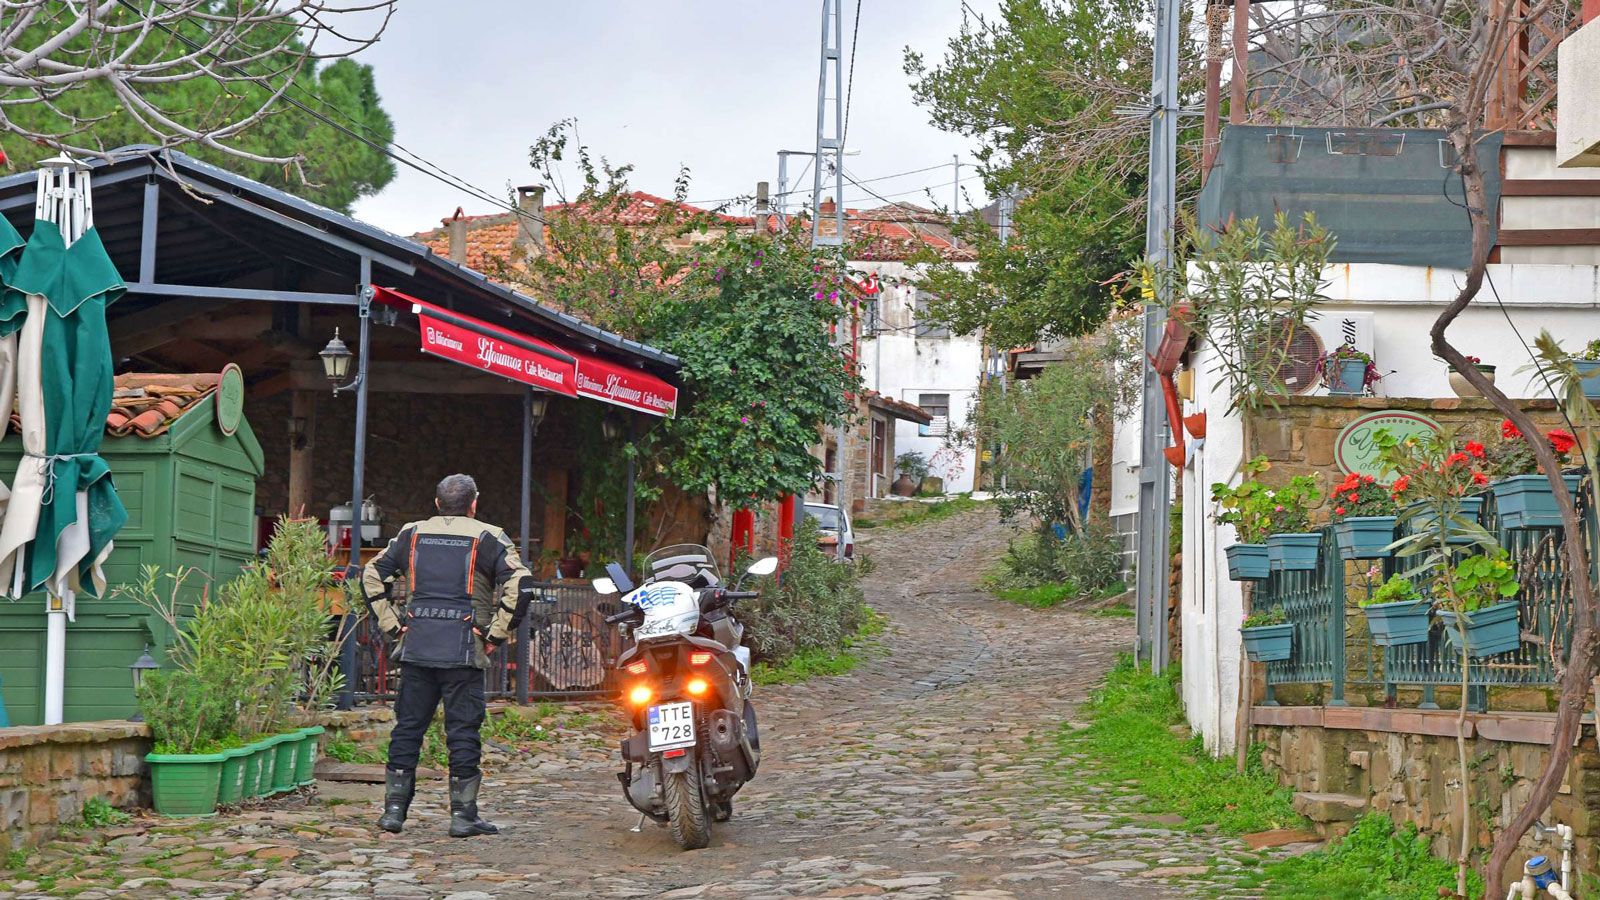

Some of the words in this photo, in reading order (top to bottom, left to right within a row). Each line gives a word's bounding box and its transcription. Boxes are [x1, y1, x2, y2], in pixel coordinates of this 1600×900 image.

[415, 607, 462, 619] SAFARI
[661, 706, 691, 722] TTE
[661, 724, 692, 741] 728
